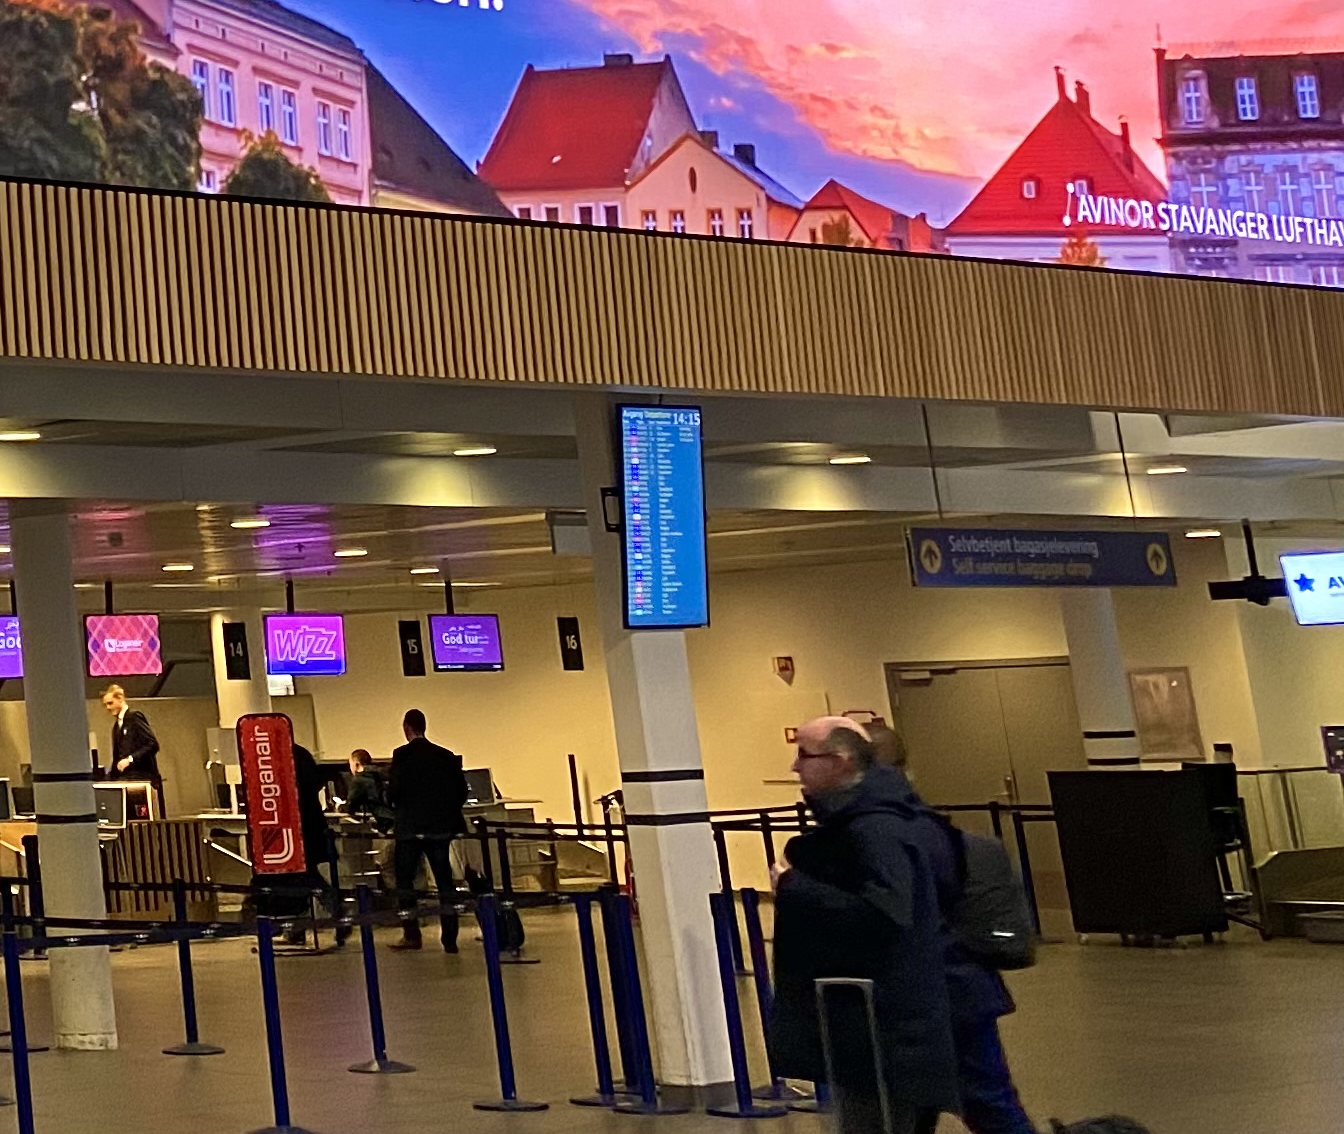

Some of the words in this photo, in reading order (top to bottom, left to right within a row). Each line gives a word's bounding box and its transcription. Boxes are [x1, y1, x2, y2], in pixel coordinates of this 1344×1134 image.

[1078, 194, 1155, 229] AVINOR
[1159, 203, 1270, 240] STAVANGER
[673, 413, 701, 425] 14:15
[442, 632, 463, 644] God
[250, 725, 281, 825] Loganair
